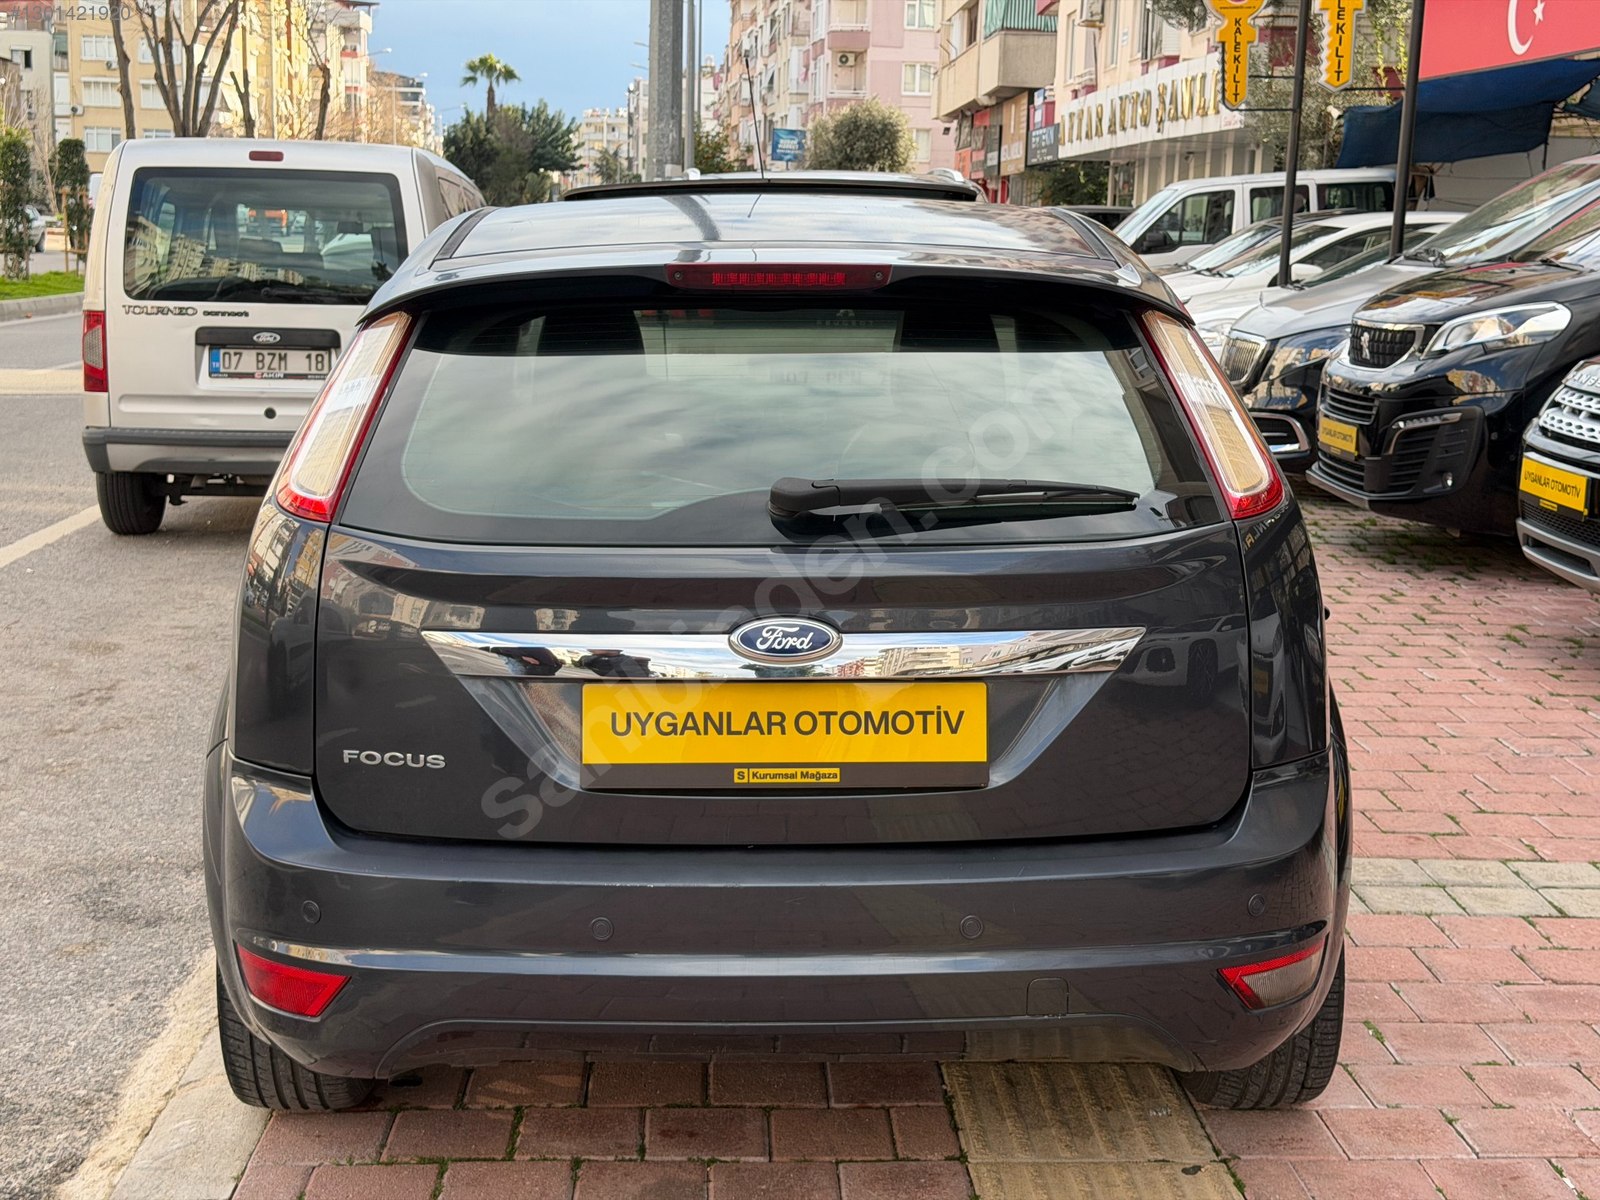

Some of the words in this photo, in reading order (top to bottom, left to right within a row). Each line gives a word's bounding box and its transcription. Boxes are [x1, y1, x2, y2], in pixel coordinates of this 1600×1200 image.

[121, 304, 198, 317] TOURNEO
[222, 352, 243, 370] 07
[256, 352, 288, 371] BZM
[305, 353, 325, 371] 18
[1524, 470, 1550, 488] UYGANLAR
[756, 624, 813, 651] Ford
[610, 711, 787, 737] UYGANLAR
[794, 705, 965, 736] OTOMOTİV
[343, 749, 446, 769] FOCUS
[752, 771, 798, 780] Kurumsal
[800, 771, 838, 782] Mağaza
